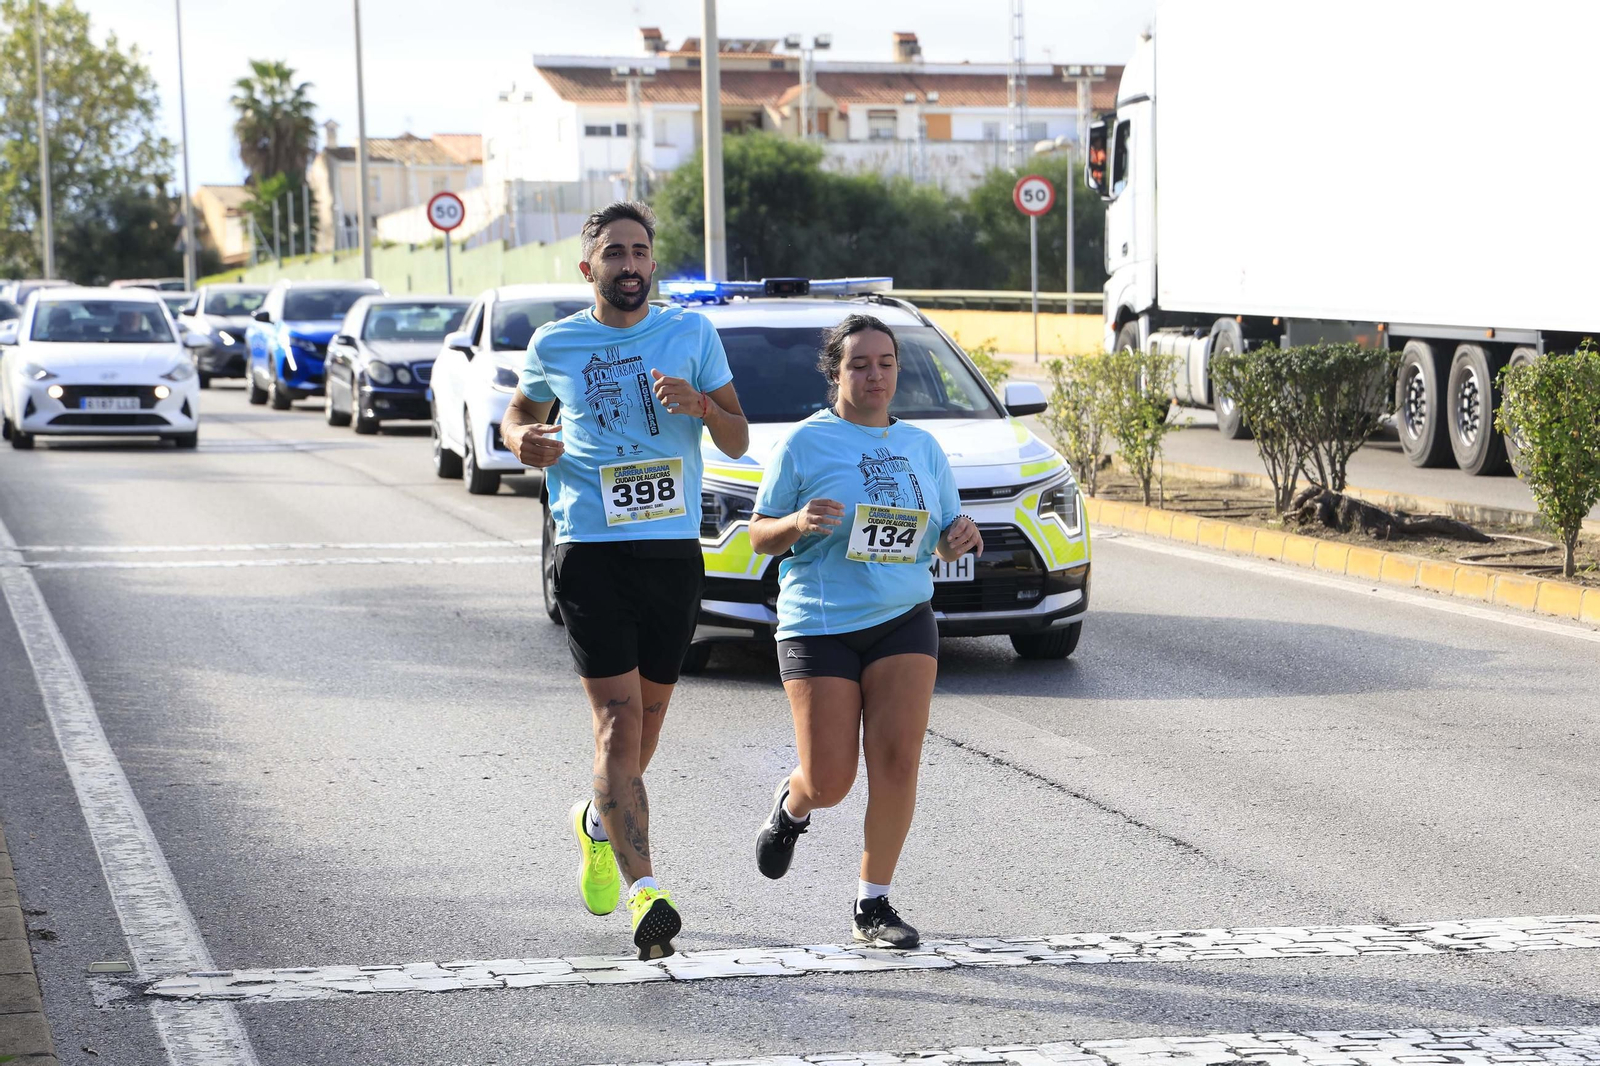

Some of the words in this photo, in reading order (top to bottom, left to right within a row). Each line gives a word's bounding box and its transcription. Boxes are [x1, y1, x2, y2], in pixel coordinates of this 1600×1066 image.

[1024, 189, 1046, 202] 50
[436, 205, 458, 219] 50
[605, 345, 620, 362] XXV
[612, 355, 643, 366] CARRERA
[611, 362, 646, 378] URBANA
[638, 373, 658, 435] ALGECIRAS
[873, 446, 891, 460] XXV
[614, 468, 644, 478] CARRERA
[644, 465, 670, 474] URBANA
[884, 460, 914, 473] URBANA
[615, 476, 636, 484] CIUDAD
[644, 471, 671, 480] ALGECIRAS
[612, 478, 675, 507] 398
[868, 517, 886, 525] CIUDAD
[892, 519, 917, 528] ALGECIRAS
[869, 511, 894, 520] CARRERA
[895, 514, 918, 522] URBANA
[862, 524, 917, 547] 134
